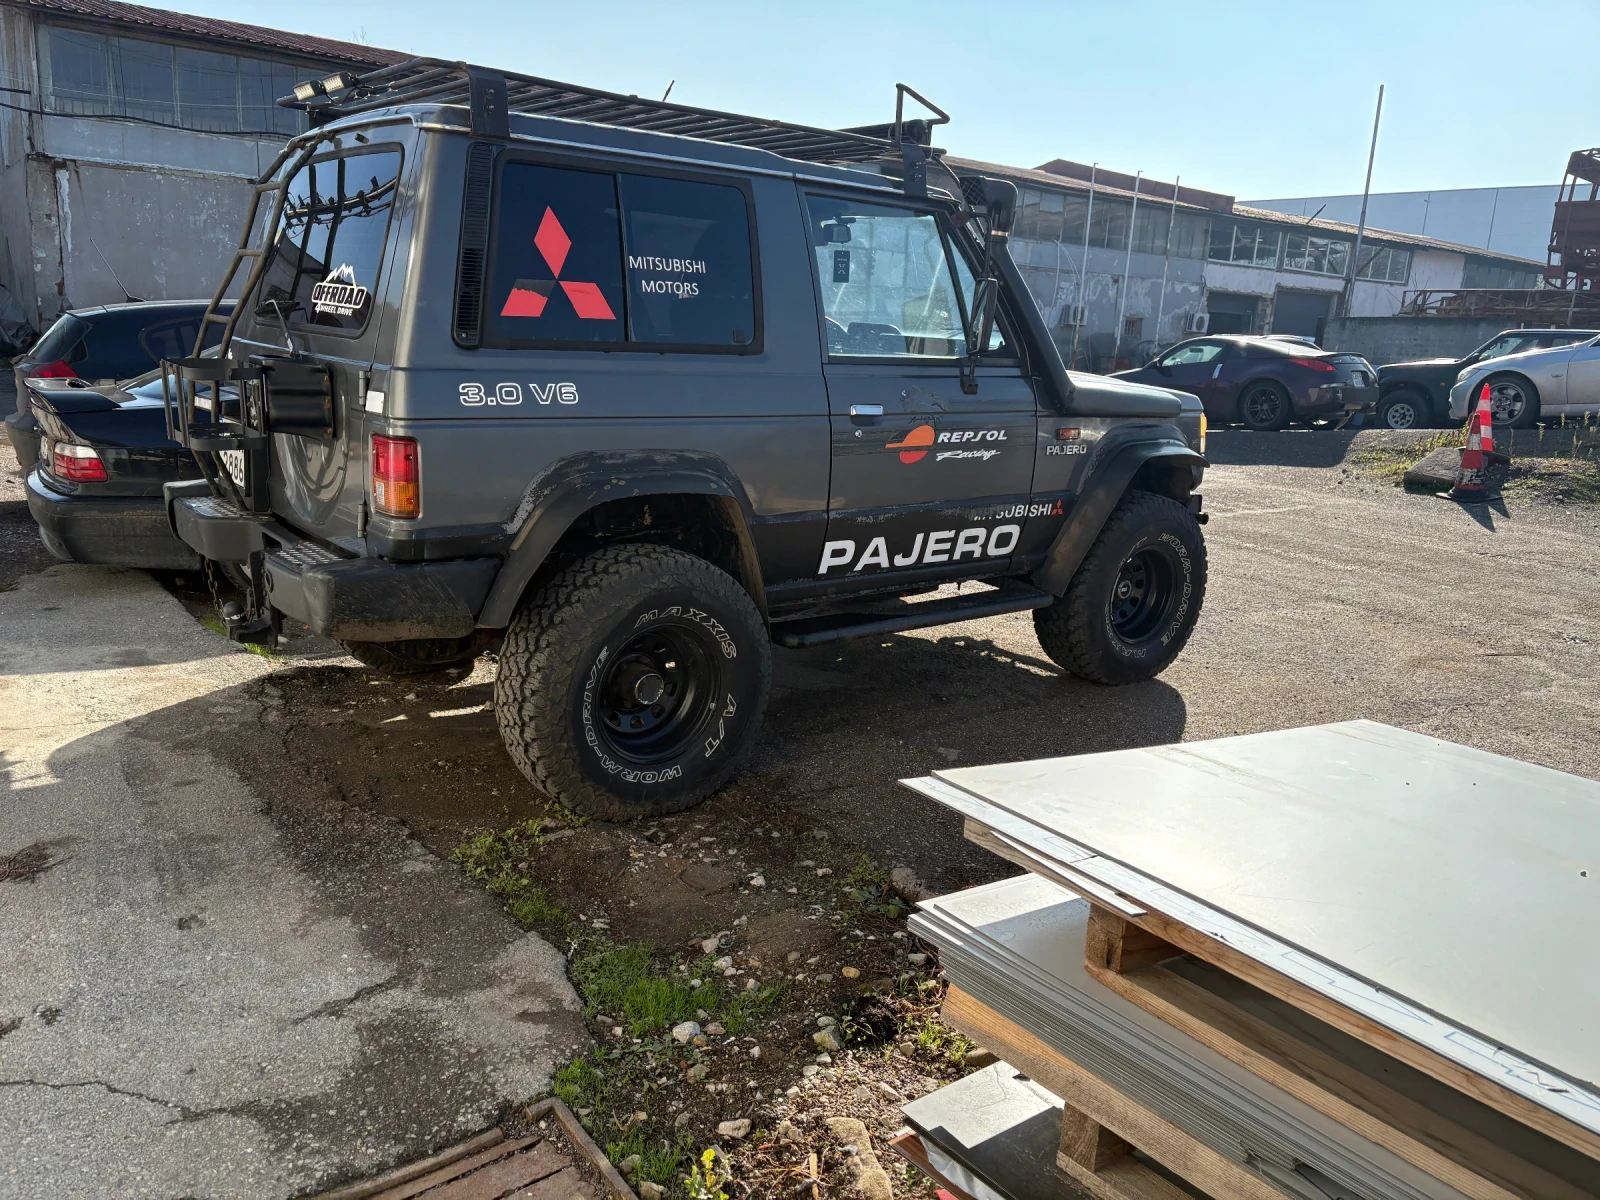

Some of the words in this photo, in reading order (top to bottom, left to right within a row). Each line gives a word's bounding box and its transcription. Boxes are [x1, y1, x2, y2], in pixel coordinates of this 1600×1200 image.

[628, 255, 706, 274] MITSUBISHI
[313, 284, 366, 306] OFFROAD
[641, 279, 699, 295] MOTORS
[337, 307, 354, 316] DRIVE
[458, 382, 523, 406] 3.0
[528, 382, 579, 405] V6
[937, 429, 1008, 443] REPSOL
[935, 449, 1001, 461] Racing
[1046, 444, 1088, 456] PAJERO
[818, 524, 1020, 574] PAJERO
[1158, 533, 1191, 646] WORM-DRIVE
[634, 607, 737, 658] MAXXIS
[583, 646, 682, 783] WORM-DRIVE
[705, 694, 737, 757] A/T
